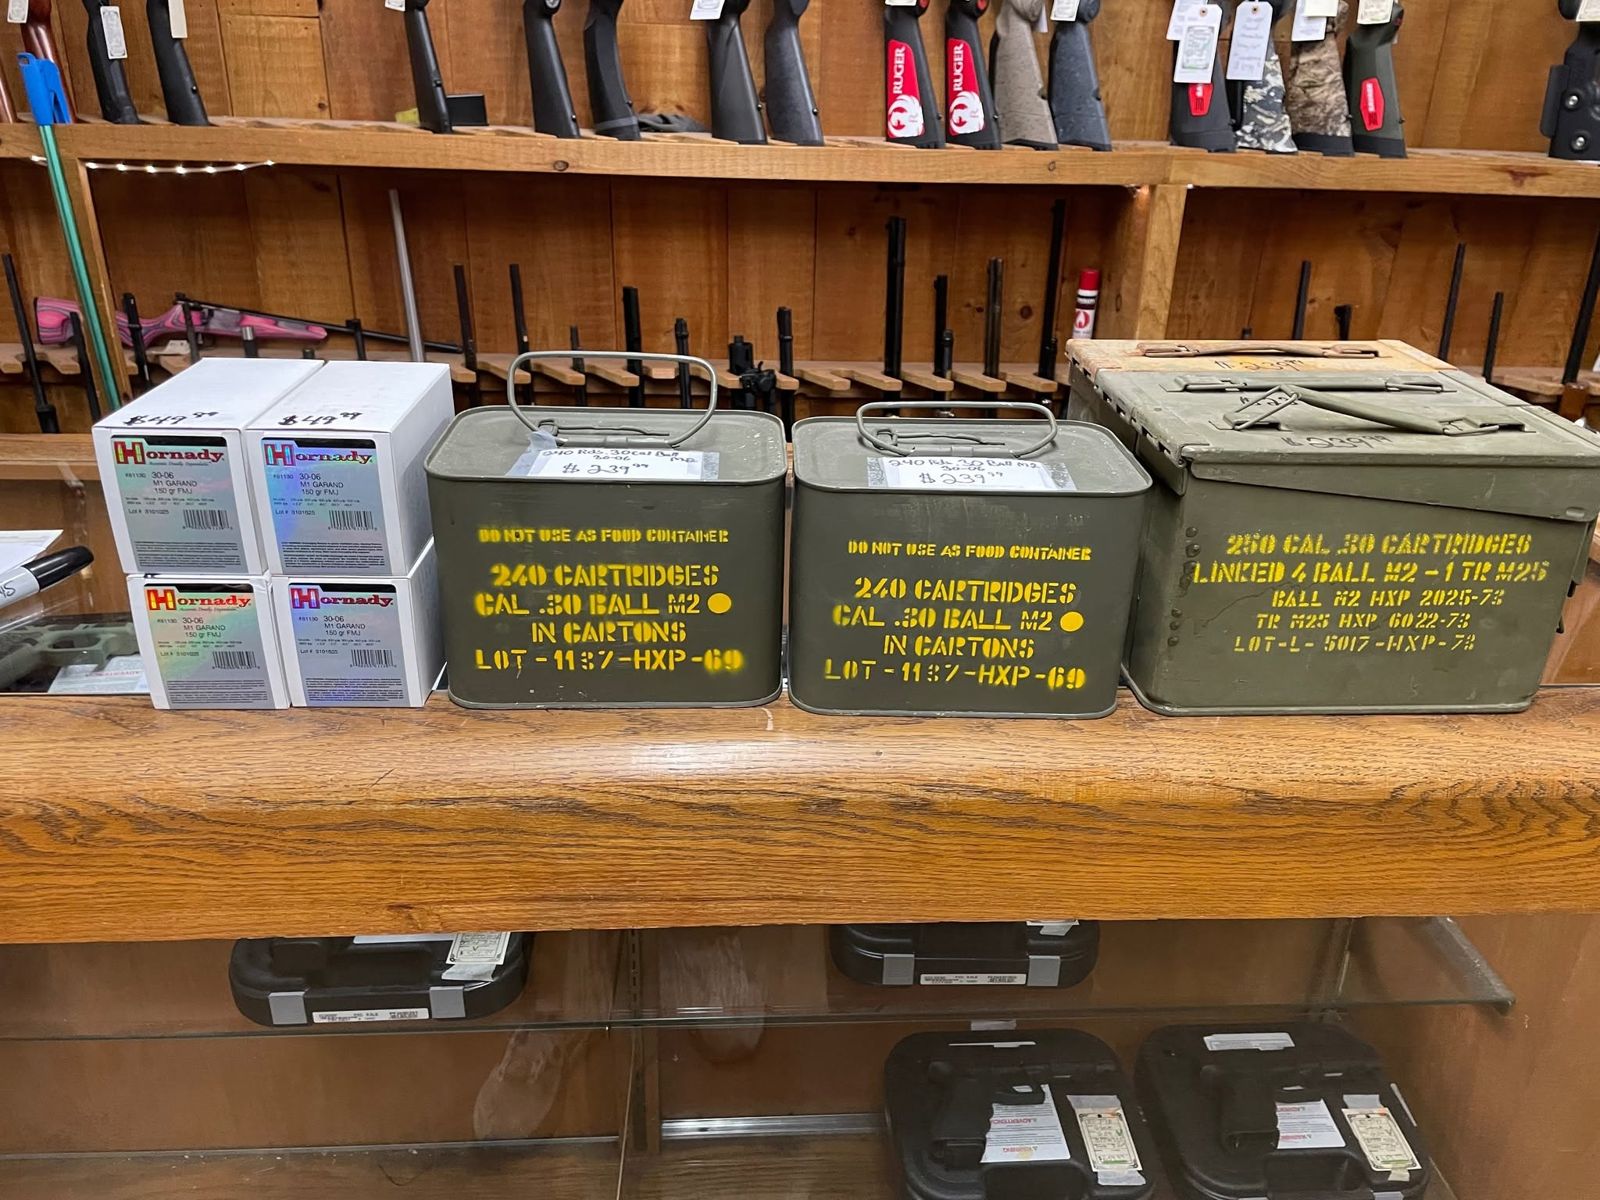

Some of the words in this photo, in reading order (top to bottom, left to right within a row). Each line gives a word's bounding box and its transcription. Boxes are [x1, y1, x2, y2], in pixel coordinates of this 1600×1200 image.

[893, 46, 905, 95] RUGER
[953, 43, 964, 92] RUGER
[113, 440, 225, 465] Hornady
[264, 443, 373, 467] Hornady
[152, 471, 174, 479] 30-06
[166, 480, 198, 488] GARAND
[299, 472, 321, 480] 30-06
[313, 481, 344, 489] GARAND
[479, 529, 500, 543] DO
[504, 529, 536, 543] NOT
[539, 529, 571, 543] USE
[576, 529, 597, 543] AS
[601, 529, 642, 543] FOOD
[646, 529, 729, 543] CONTAINER
[1226, 534, 1276, 555] 250
[1283, 534, 1331, 555] CAL
[1337, 534, 1376, 555] .30
[1381, 534, 1533, 555] CARTRIDGES
[848, 541, 868, 554] DO
[872, 542, 902, 556] NOT
[906, 544, 936, 556] USE
[941, 545, 961, 557] AS
[966, 545, 1005, 558] FOOD
[1009, 545, 1092, 561] CONTAINER
[490, 564, 548, 587] 240
[554, 564, 719, 587] CARTRIDGES
[1193, 561, 1285, 583] LINKED
[1291, 563, 1307, 583] 4
[1313, 561, 1376, 583] BALL
[1384, 562, 1418, 583] M2
[1461, 562, 1488, 582] TR
[1495, 561, 1550, 583] M25
[146, 588, 252, 611] Hornady
[290, 587, 393, 610] Hornady
[855, 578, 907, 599] 240
[914, 580, 1077, 604] CARTRIDGES
[1272, 590, 1323, 608] BALL
[1334, 590, 1361, 608] M2
[1370, 590, 1412, 608] HXP
[474, 592, 530, 616] CAL
[538, 594, 582, 615] .30
[589, 593, 660, 616] BALL
[668, 593, 700, 615] M2
[323, 615, 345, 623] 30-06
[832, 604, 885, 626] CAL
[895, 608, 937, 629] .30
[943, 608, 1012, 630] BALL
[1020, 611, 1053, 631] M2
[1256, 613, 1281, 630] TR
[1290, 613, 1330, 630] M25
[1339, 613, 1378, 629] HXP
[1389, 612, 1471, 629] 6022-73
[531, 621, 557, 643] IN
[564, 621, 687, 644] CARTONS
[884, 634, 908, 655] IN
[914, 635, 1036, 659] CARTONS
[475, 649, 527, 670] LOT
[824, 658, 876, 681] LOT
